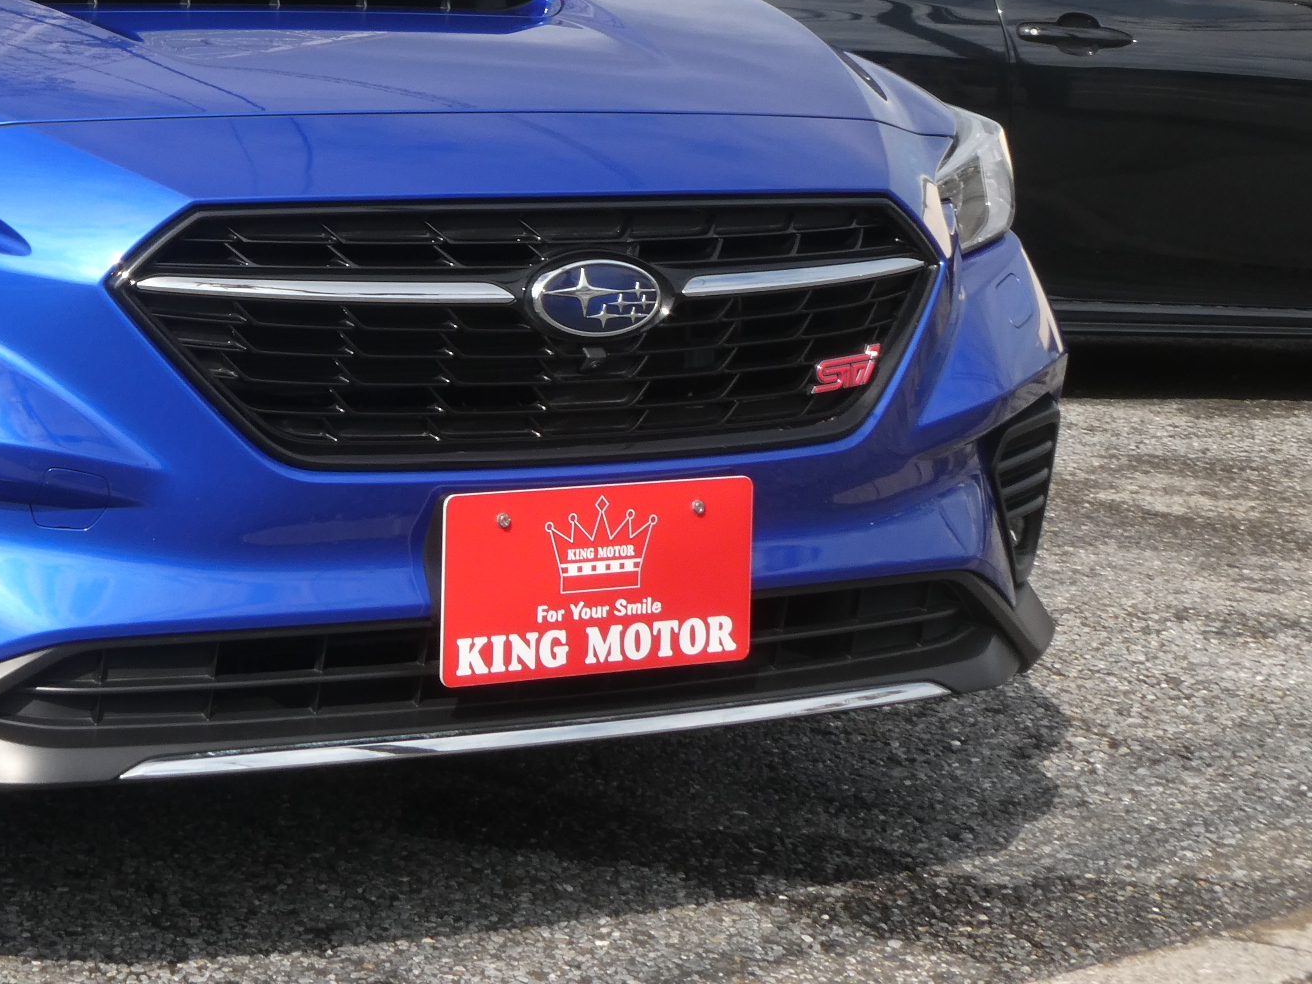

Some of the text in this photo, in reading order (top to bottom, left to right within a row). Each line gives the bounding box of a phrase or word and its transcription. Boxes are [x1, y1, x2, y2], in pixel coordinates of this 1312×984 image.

[567, 544, 635, 561] KING MOTOR
[537, 597, 662, 623] For Your Smile
[455, 615, 737, 677] KING MOTOR
